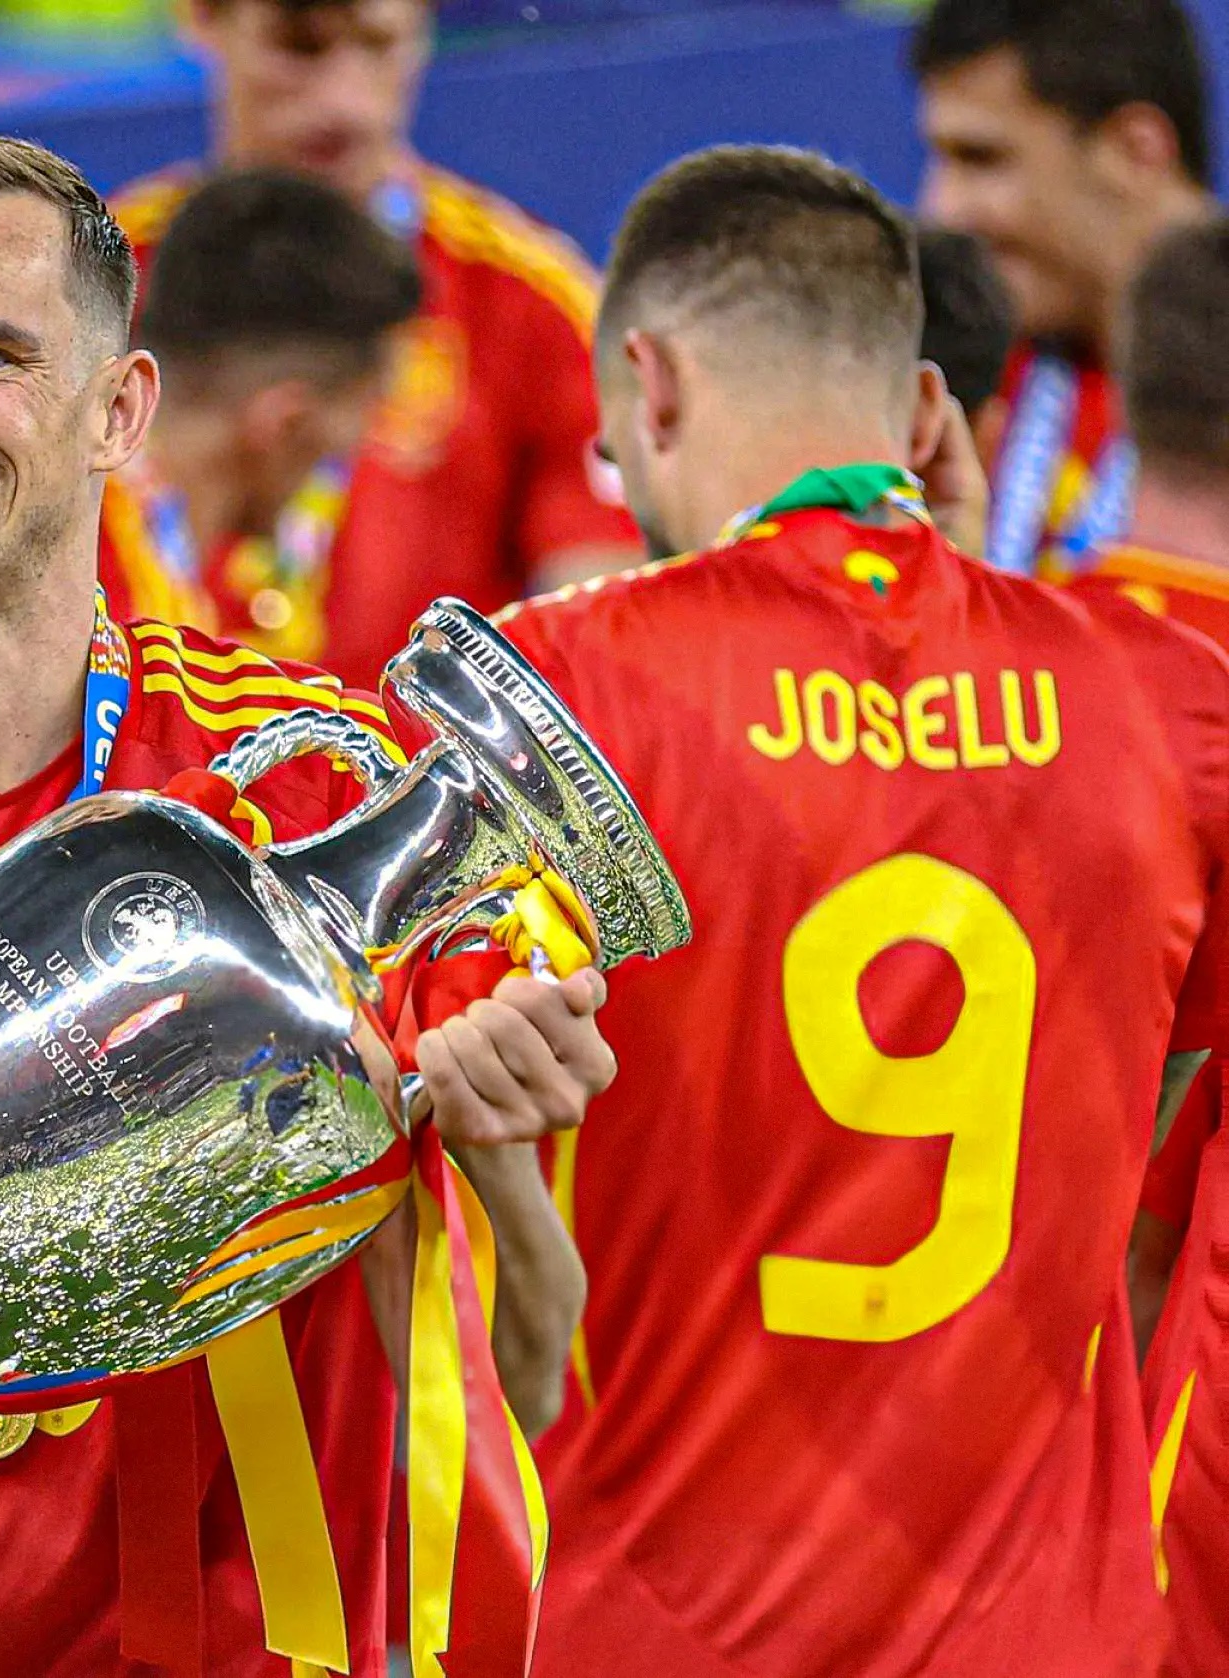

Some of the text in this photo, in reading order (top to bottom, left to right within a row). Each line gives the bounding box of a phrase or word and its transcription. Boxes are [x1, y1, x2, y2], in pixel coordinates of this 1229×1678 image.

[747, 667, 1061, 771] JOSELU
[51, 1005, 140, 1114] OOTBALL
[759, 852, 1037, 1343] 9
